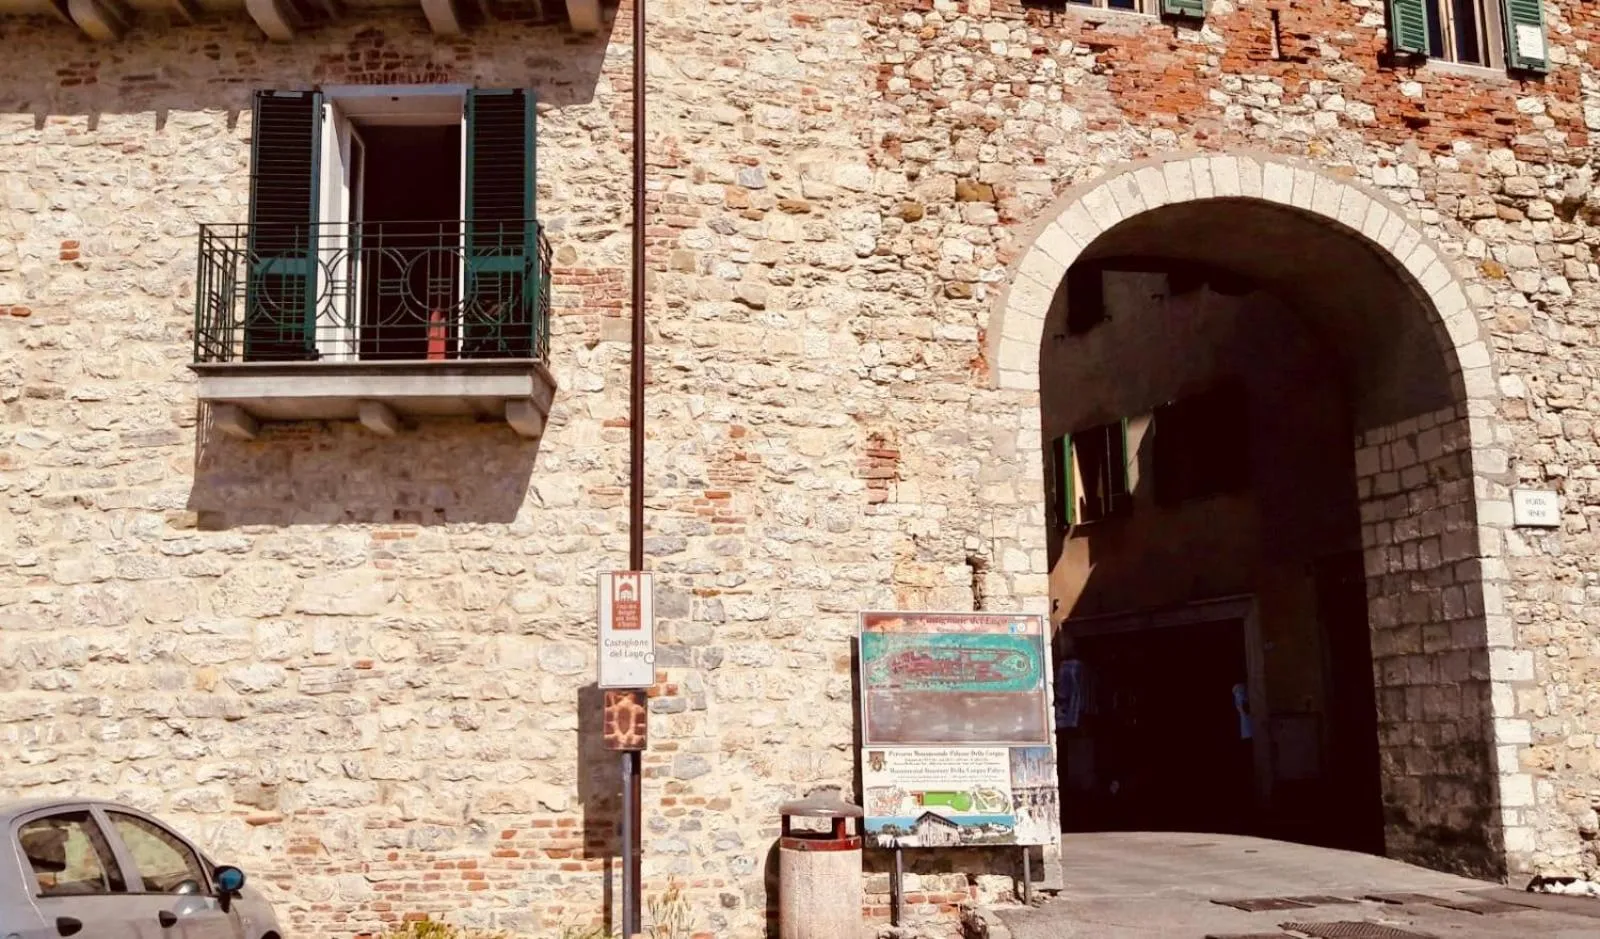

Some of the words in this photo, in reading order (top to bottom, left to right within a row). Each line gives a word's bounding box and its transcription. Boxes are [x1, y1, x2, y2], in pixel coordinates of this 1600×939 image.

[604, 638, 649, 649] Castiglione
[609, 649, 623, 658] del
[624, 649, 645, 660] Lago
